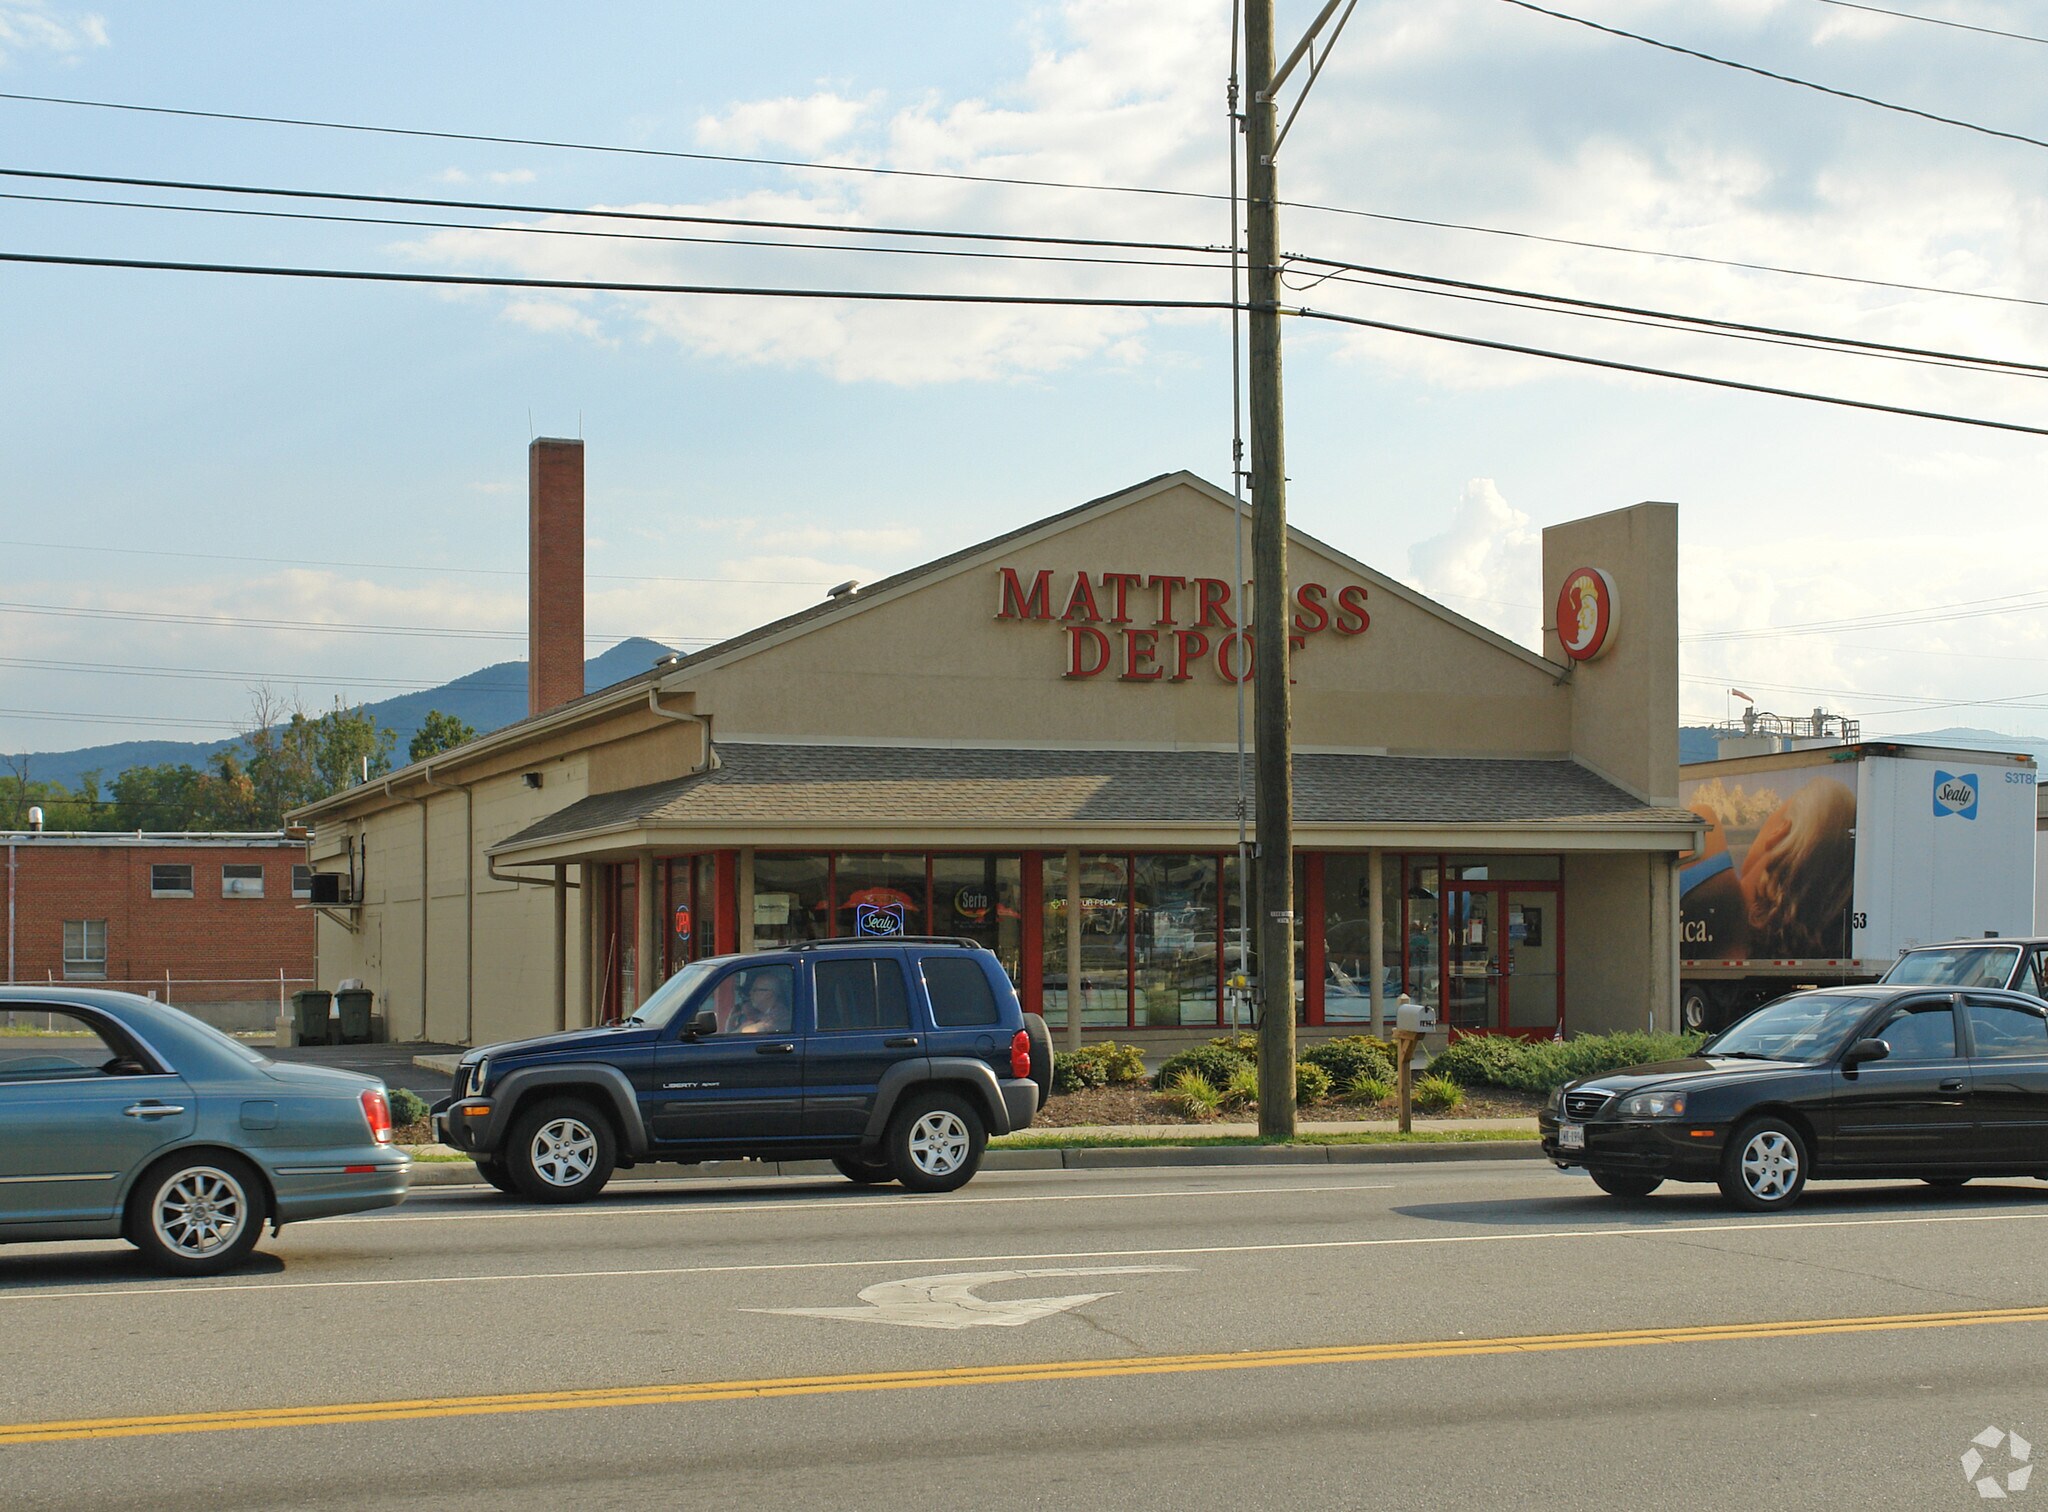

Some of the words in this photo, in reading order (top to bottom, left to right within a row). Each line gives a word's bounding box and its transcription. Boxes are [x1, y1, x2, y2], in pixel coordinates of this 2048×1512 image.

[996, 567, 1371, 636] MATTRSS
[1939, 783, 1971, 806] Sealy
[962, 892, 987, 908] Serta
[864, 913, 895, 931] Sealy
[1853, 912, 1867, 929] 53
